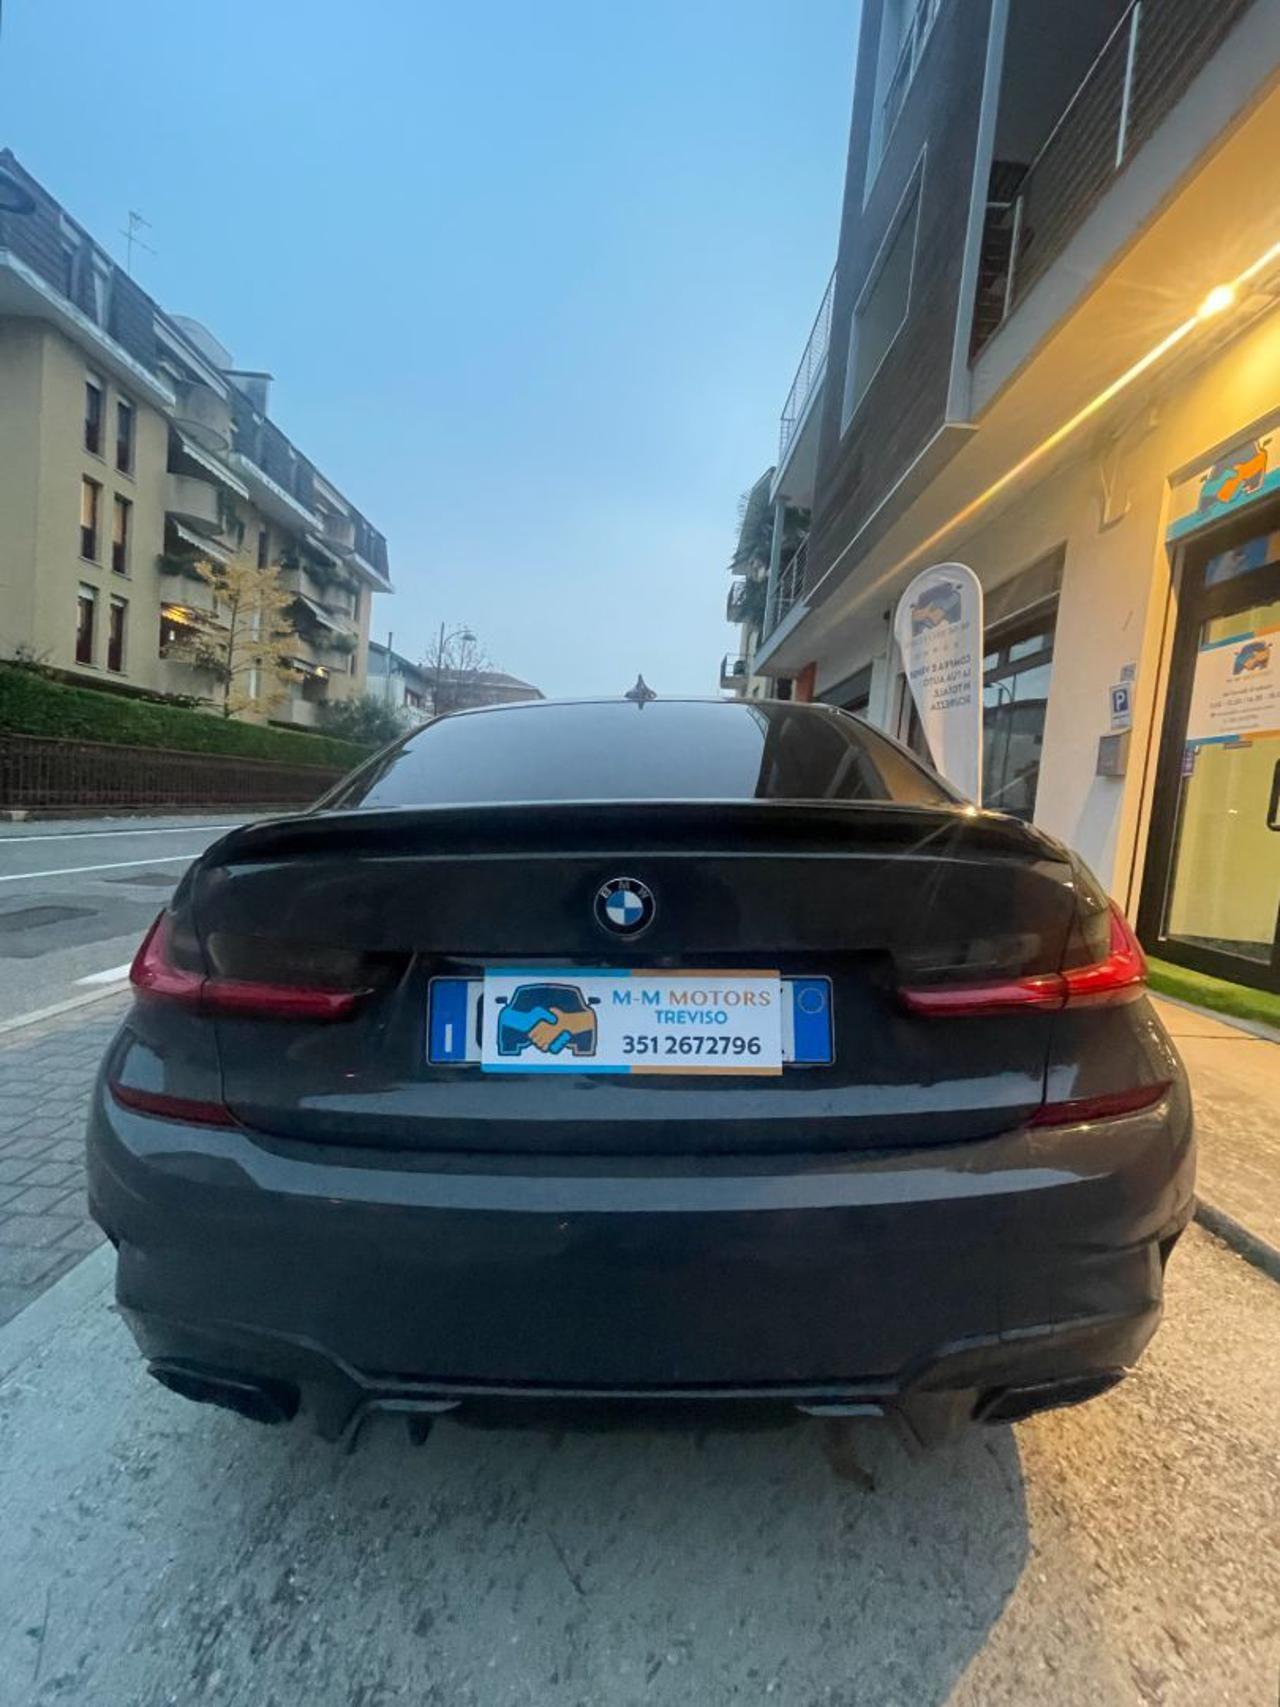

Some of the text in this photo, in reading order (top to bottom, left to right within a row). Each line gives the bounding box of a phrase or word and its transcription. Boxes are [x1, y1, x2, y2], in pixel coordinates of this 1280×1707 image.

[1115, 691, 1125, 711] P
[601, 881, 649, 899] BMW
[612, 990, 771, 1007] M-M MOTORS
[655, 1010, 728, 1025] TREVISO
